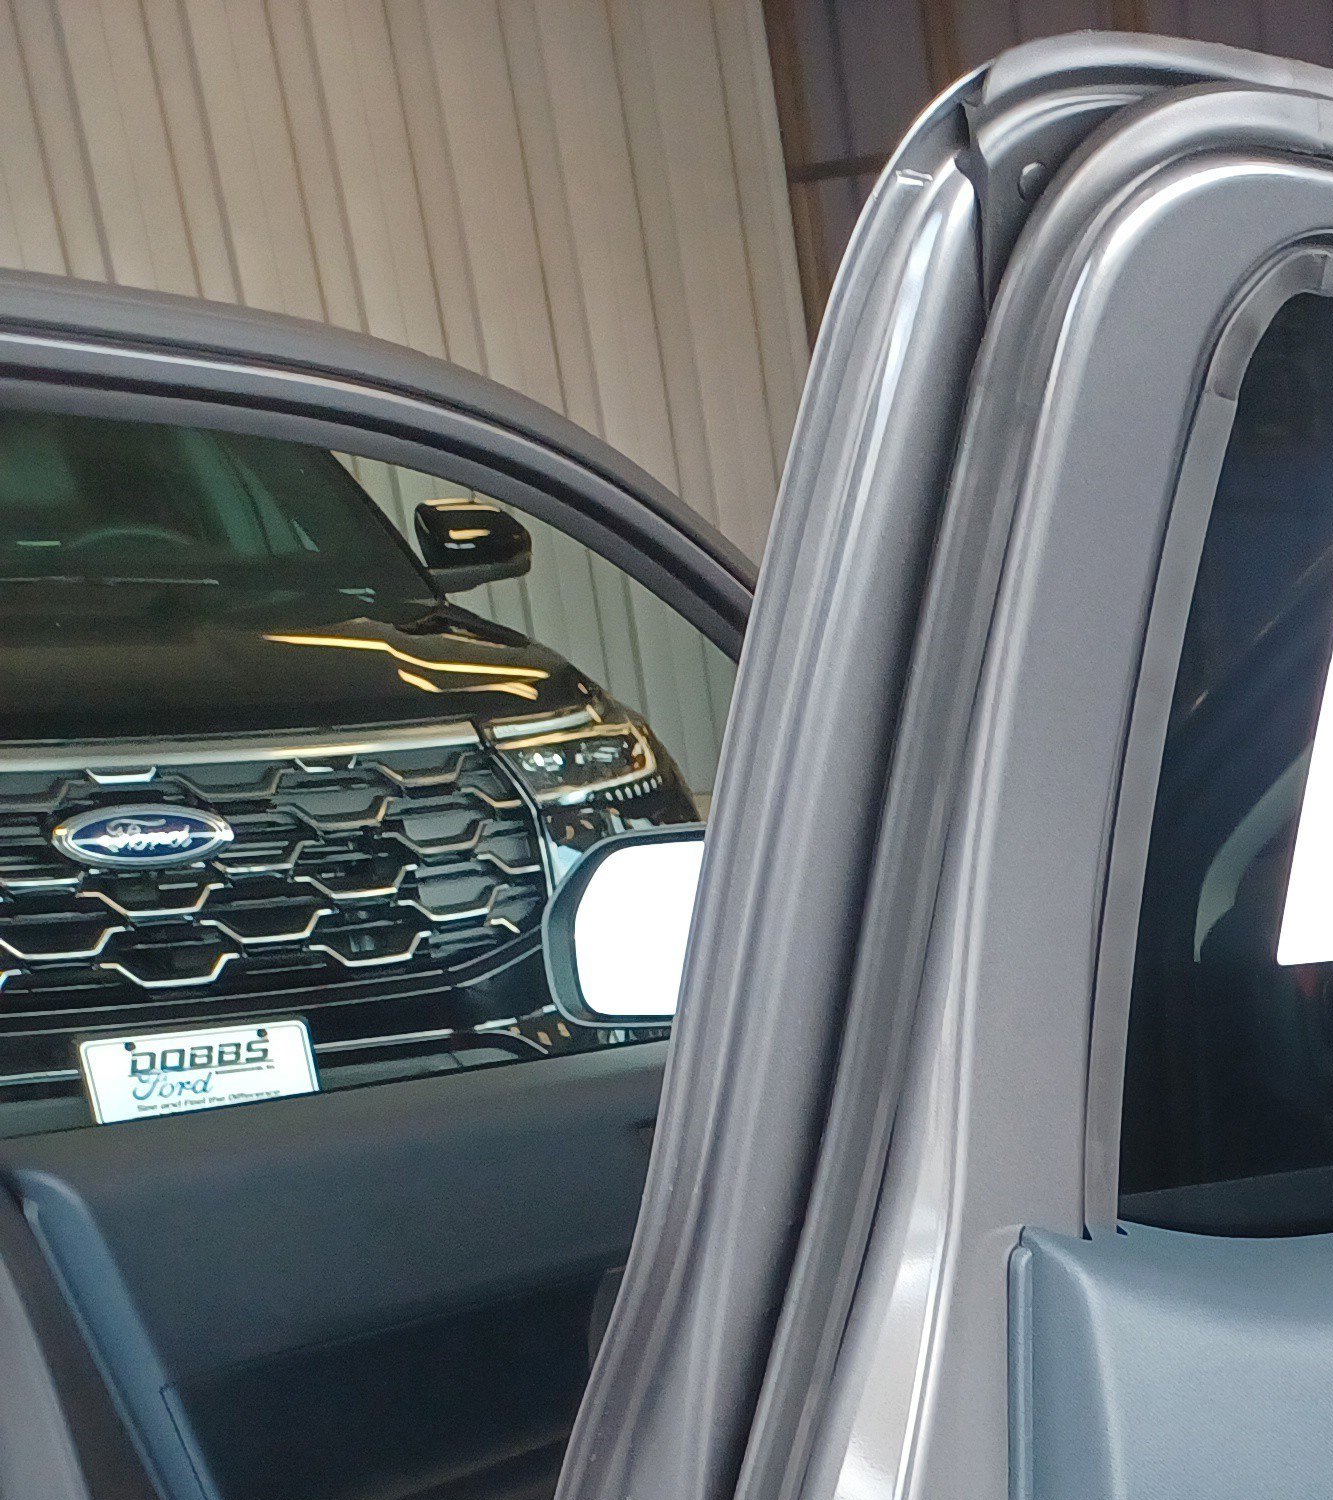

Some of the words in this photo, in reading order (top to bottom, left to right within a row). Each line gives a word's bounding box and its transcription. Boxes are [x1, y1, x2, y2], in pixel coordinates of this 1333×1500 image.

[98, 818, 191, 853] Ford
[130, 1039, 270, 1077] DOBBS
[131, 1071, 213, 1101] Ford
